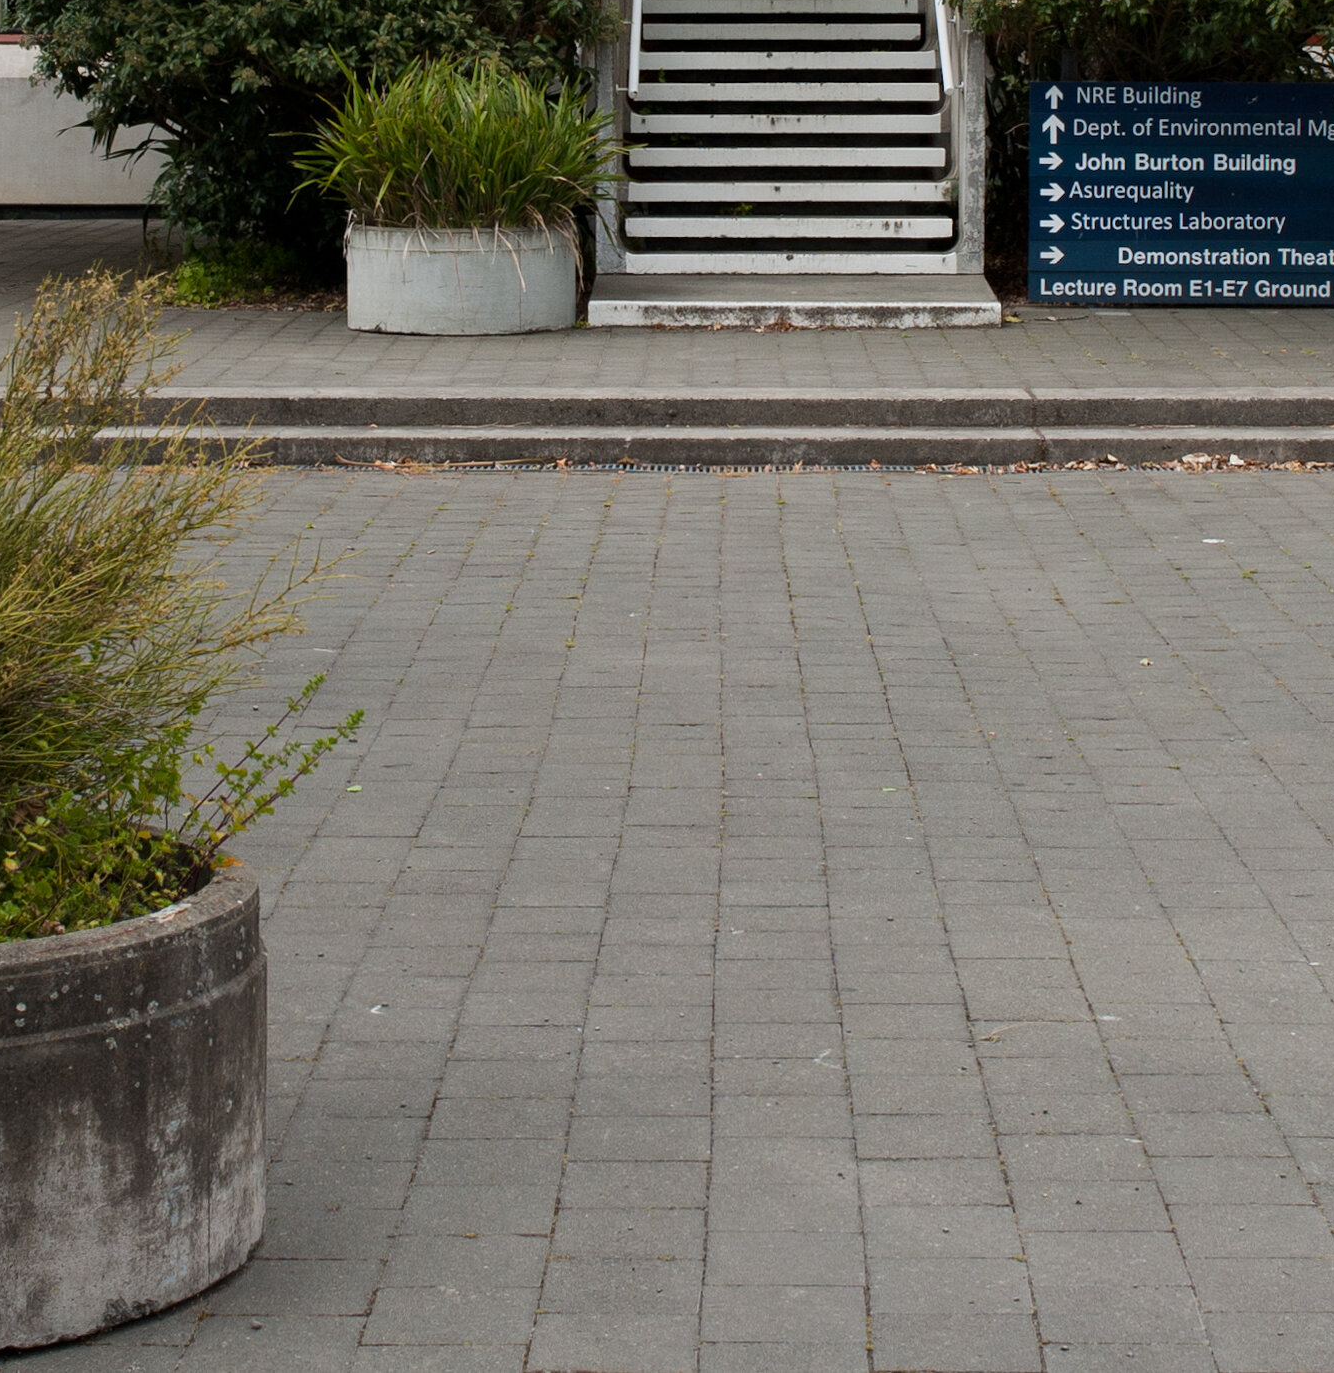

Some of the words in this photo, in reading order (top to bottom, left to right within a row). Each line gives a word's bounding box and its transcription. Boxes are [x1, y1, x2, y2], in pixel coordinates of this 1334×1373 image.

[1077, 86, 1116, 104] NRE
[1123, 86, 1202, 109] Building
[1073, 118, 1126, 140] Dept.
[1132, 117, 1154, 136] of
[1159, 118, 1301, 136] Environmental
[1075, 152, 1126, 171] John
[1135, 153, 1205, 172] Burton
[1213, 153, 1296, 176] Building
[1068, 180, 1195, 204] Asurequality
[1071, 212, 1173, 231] Structures
[1179, 211, 1286, 234] Laboratory
[1118, 246, 1271, 266] Demonstration
[1040, 278, 1117, 297] Lecture
[1123, 278, 1183, 297] Room
[1189, 279, 1249, 297] E1-E7
[1254, 279, 1331, 298] Ground
